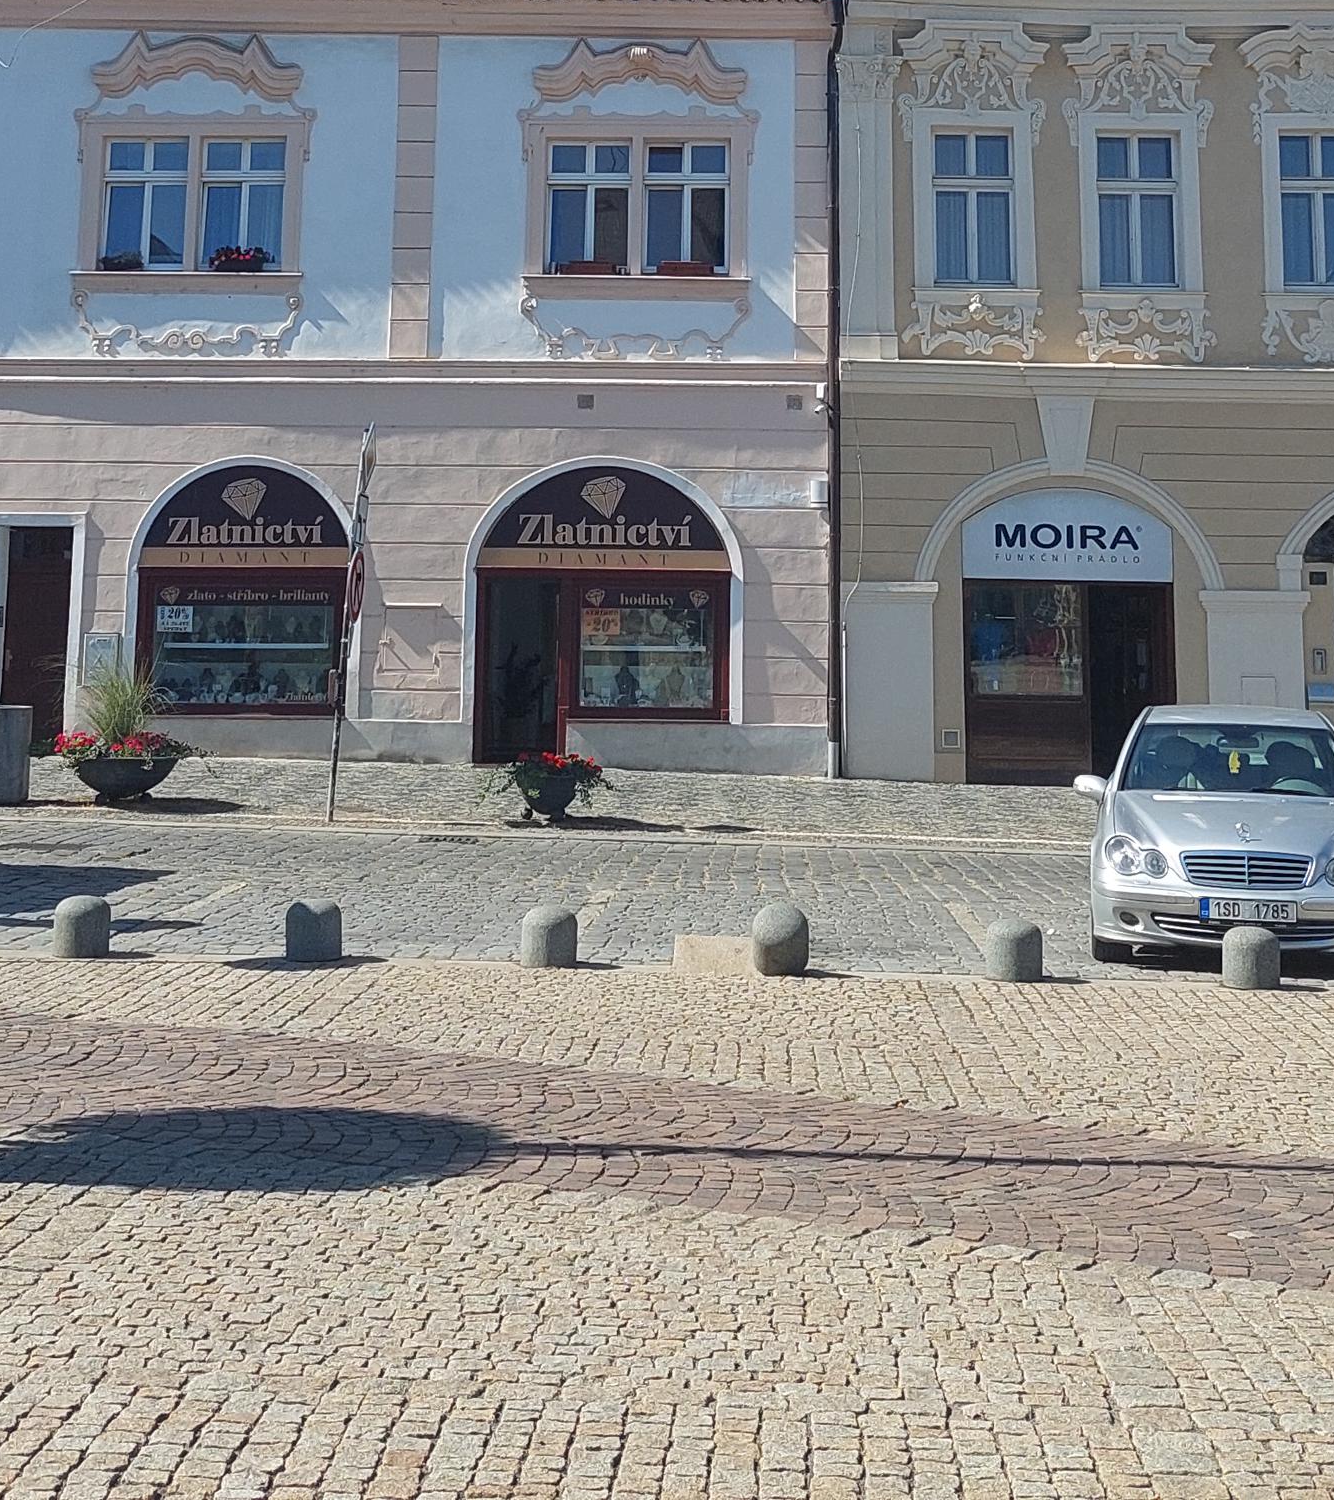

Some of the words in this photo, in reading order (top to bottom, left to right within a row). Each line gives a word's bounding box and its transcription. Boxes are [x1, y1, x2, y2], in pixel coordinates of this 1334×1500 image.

[166, 516, 324, 544] Zlatnictví
[517, 514, 692, 546] Zlatnictví
[994, 523, 1140, 550] MOIRA
[179, 551, 311, 564] DIAMANT
[538, 552, 669, 565] DIAMANT
[995, 552, 1067, 563] FUNKČNÍ
[1077, 553, 1141, 564] PRÁDLO
[186, 589, 216, 601] zlato
[620, 592, 675, 609] hodinky
[1214, 902, 1241, 918] 1SD
[1253, 903, 1290, 920] 1785
